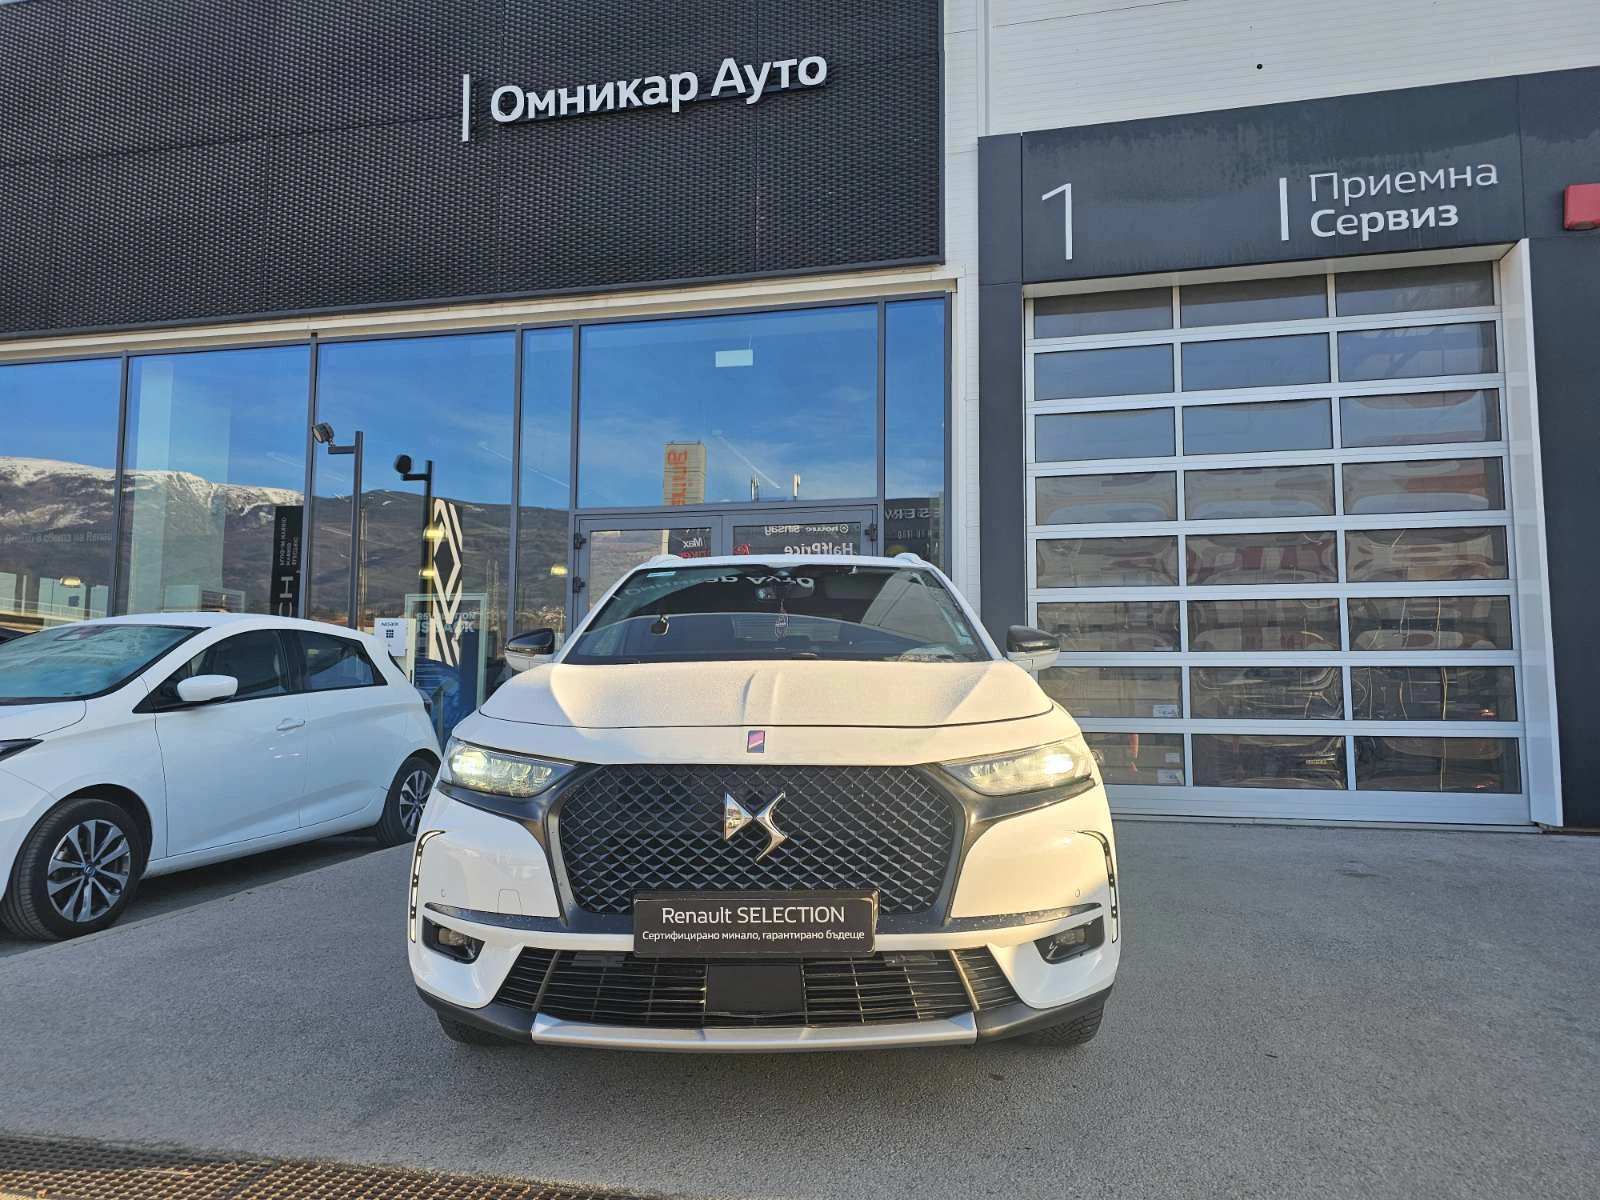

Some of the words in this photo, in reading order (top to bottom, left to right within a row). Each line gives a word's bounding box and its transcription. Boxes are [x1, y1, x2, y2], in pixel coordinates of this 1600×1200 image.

[490, 71, 698, 123] Омникар
[710, 54, 827, 105] Ауто
[1309, 163, 1499, 206] Приемна
[1041, 183, 1075, 261] 1
[1309, 204, 1460, 242] Сервиз
[662, 906, 732, 924] Renault
[737, 906, 846, 924] SELECTION
[642, 930, 720, 943] Сертифицирано
[721, 931, 761, 942] минало,
[762, 930, 824, 942] гарантирано
[825, 930, 865, 942] бъдеще
